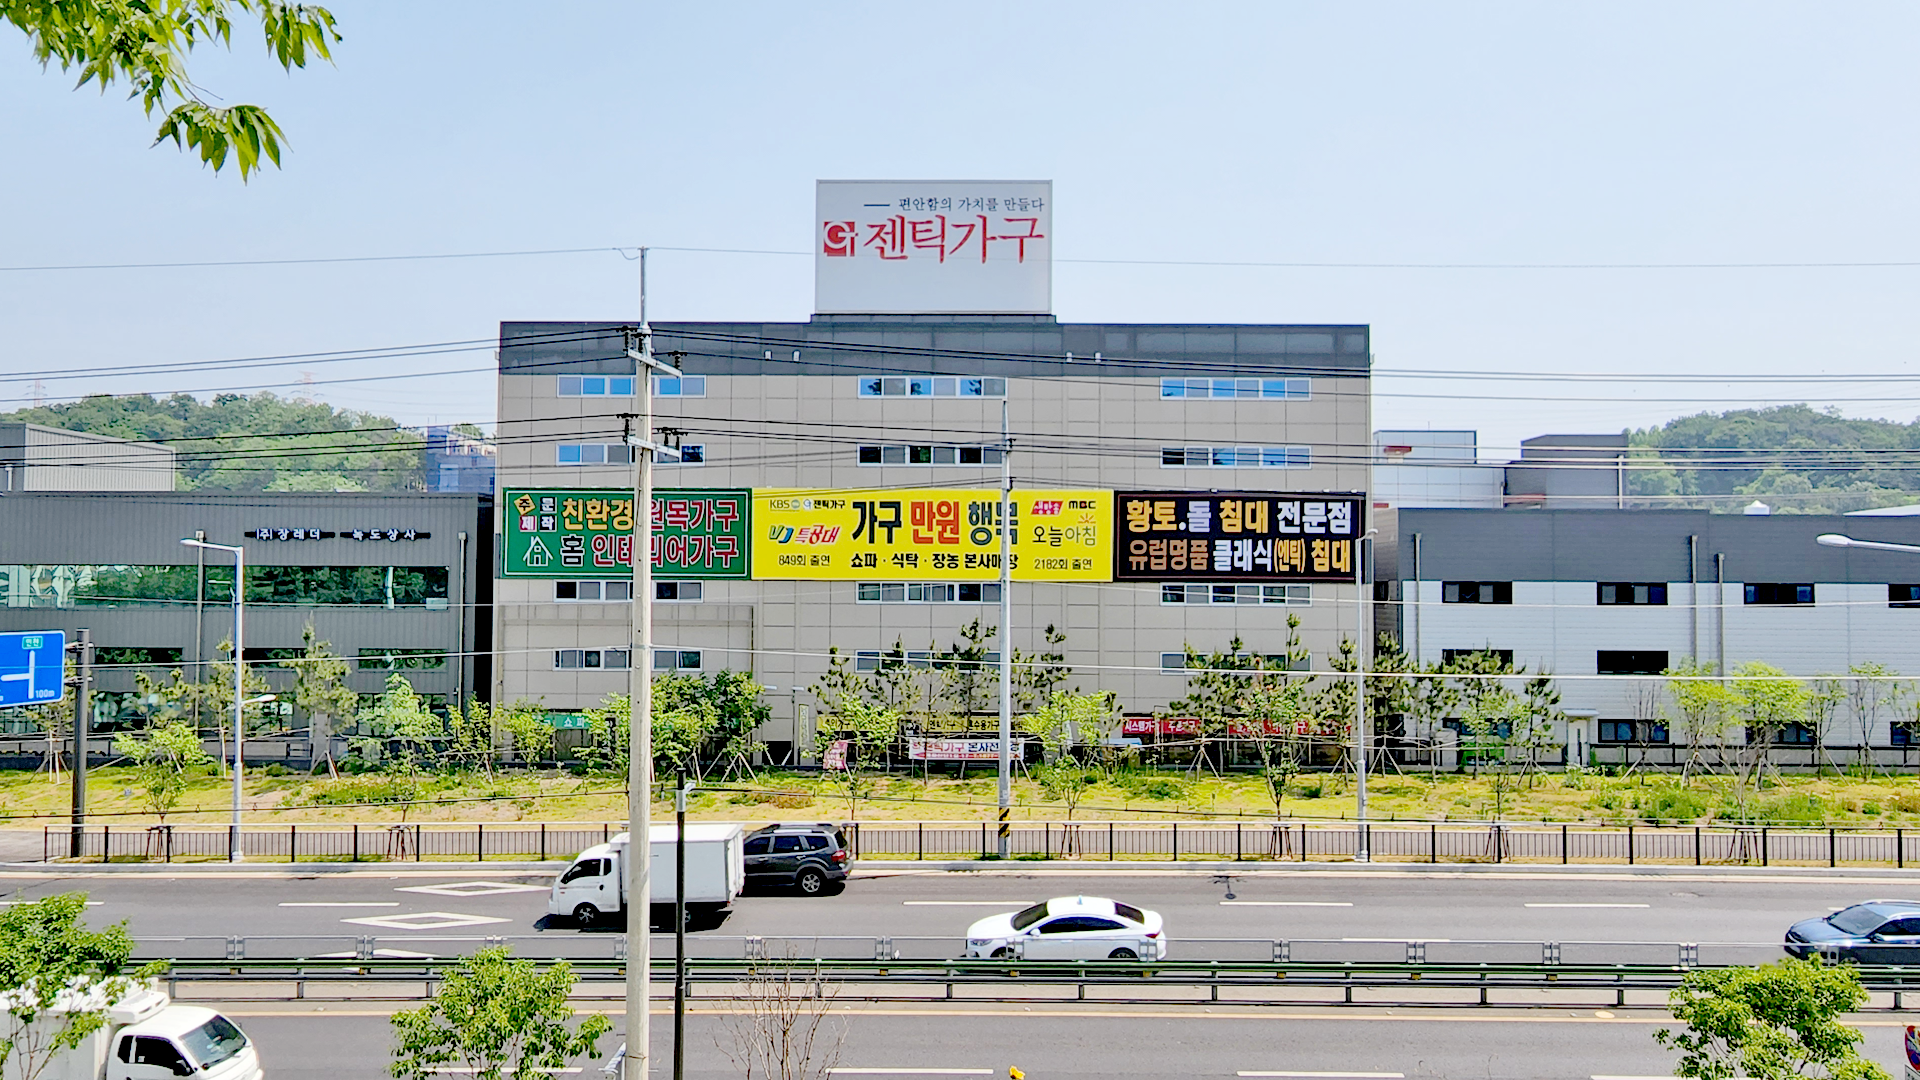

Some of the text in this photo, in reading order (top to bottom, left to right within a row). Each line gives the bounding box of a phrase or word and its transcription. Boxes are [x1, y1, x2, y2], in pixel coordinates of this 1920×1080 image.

[899, 197, 1045, 211] 편안함의 가치를 만들다
[863, 214, 1044, 264] 젠틱가구
[562, 498, 634, 531] 친환경
[770, 500, 790, 509] KBS
[1219, 500, 1268, 534] 침대
[1277, 501, 1351, 534] 전문점
[795, 525, 841, 544] 특공대
[852, 501, 1018, 545] 가구 만원 행복
[560, 534, 585, 567] 홈
[778, 555, 830, 567] 849회 출연
[1129, 539, 1209, 571] 유럽명품
[1311, 539, 1351, 573] 침대
[1034, 559, 1093, 570] 2182회 출연
[35, 689, 55, 699] 100m
